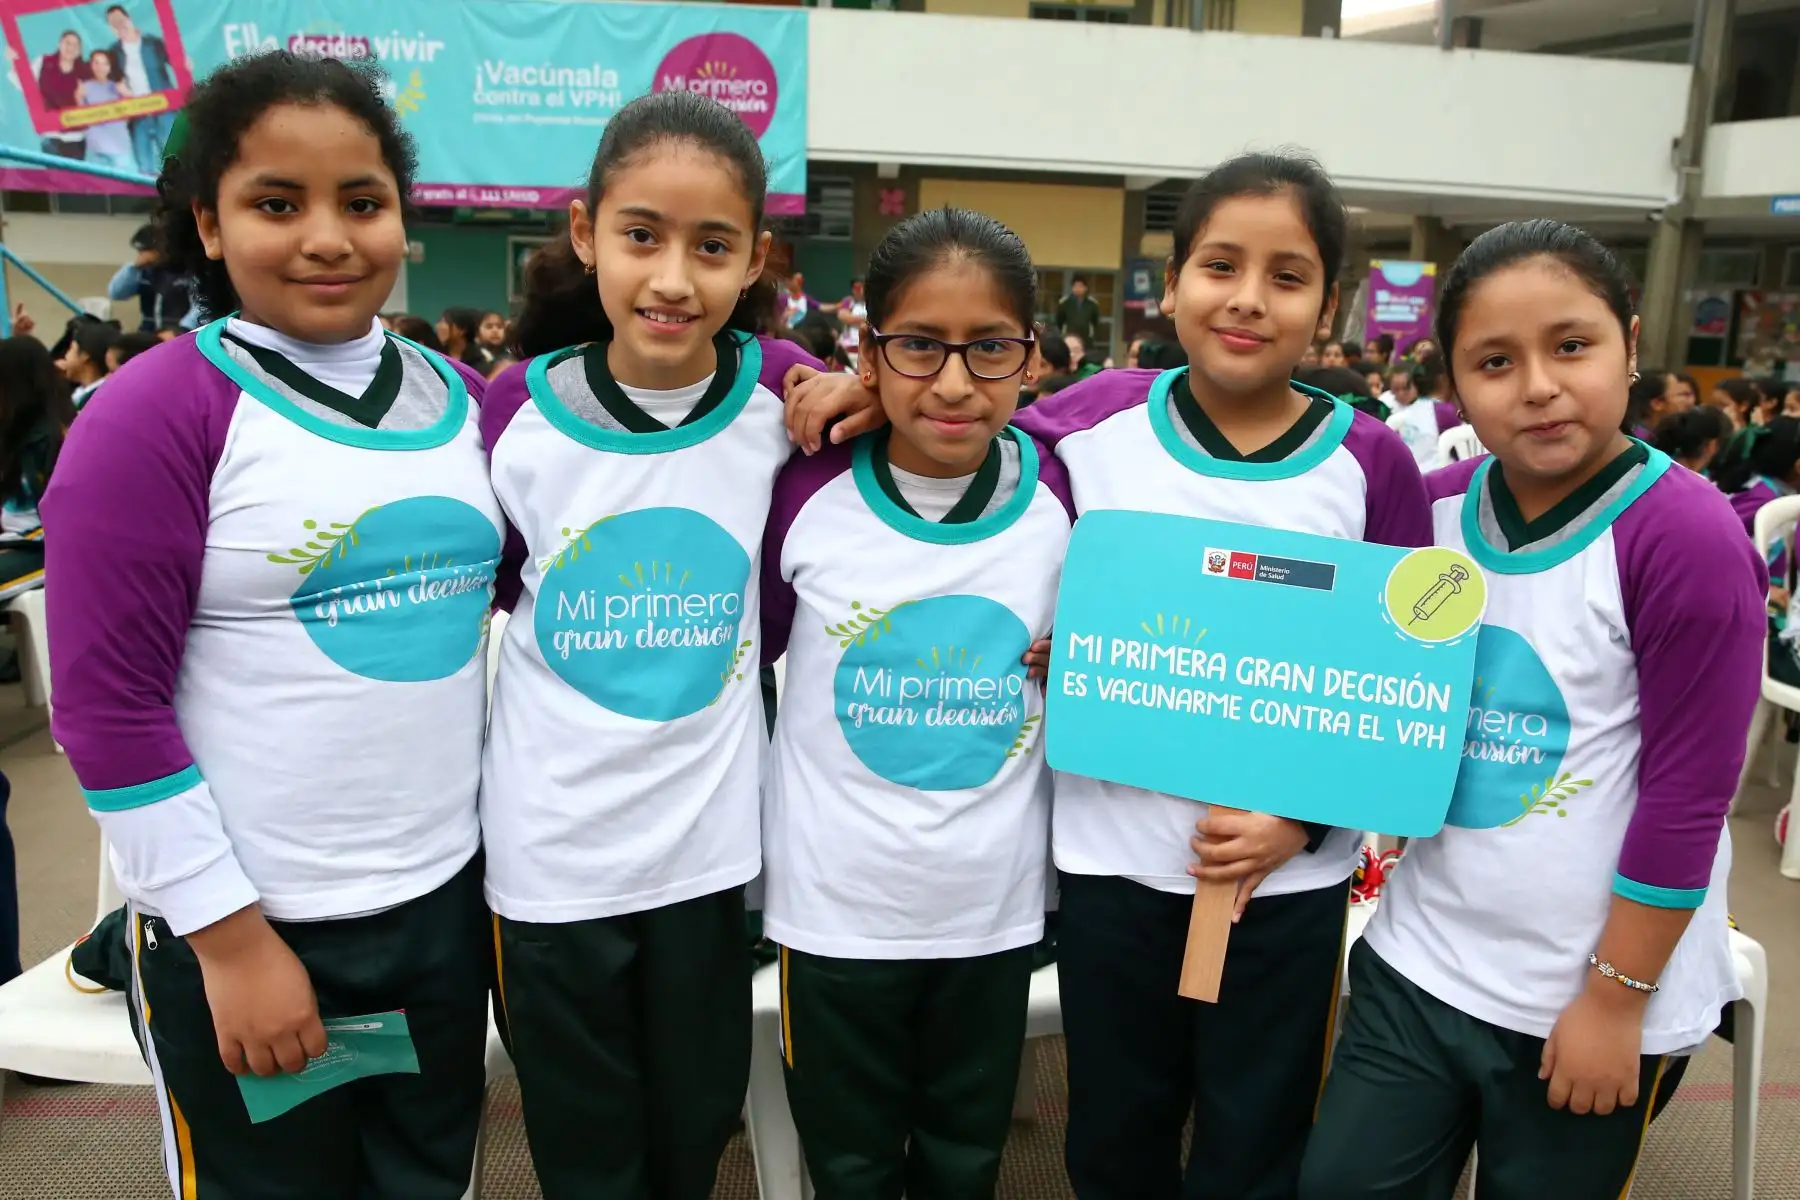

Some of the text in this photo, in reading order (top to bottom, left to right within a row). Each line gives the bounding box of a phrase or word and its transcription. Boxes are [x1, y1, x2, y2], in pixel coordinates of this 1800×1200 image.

[373, 29, 445, 62] vivir
[475, 59, 619, 93] ¡Vacúnala
[473, 90, 541, 106] contra
[545, 91, 566, 107] el
[1232, 560, 1254, 571] PERÚ
[1259, 564, 1291, 575] Ministerio
[1268, 572, 1285, 580] Salud
[556, 587, 740, 628] Mi primera
[553, 618, 735, 660] gran decisión
[853, 666, 1023, 707] Mi primera
[1068, 631, 1451, 713] MI PRIMERA GRAN DECISIÓN
[847, 701, 1018, 728] gran decisión
[1063, 671, 1446, 751] ES VACUNARME CONTRA EL VPH
[1467, 706, 1548, 737] mera
[1461, 734, 1546, 765] ecisión
